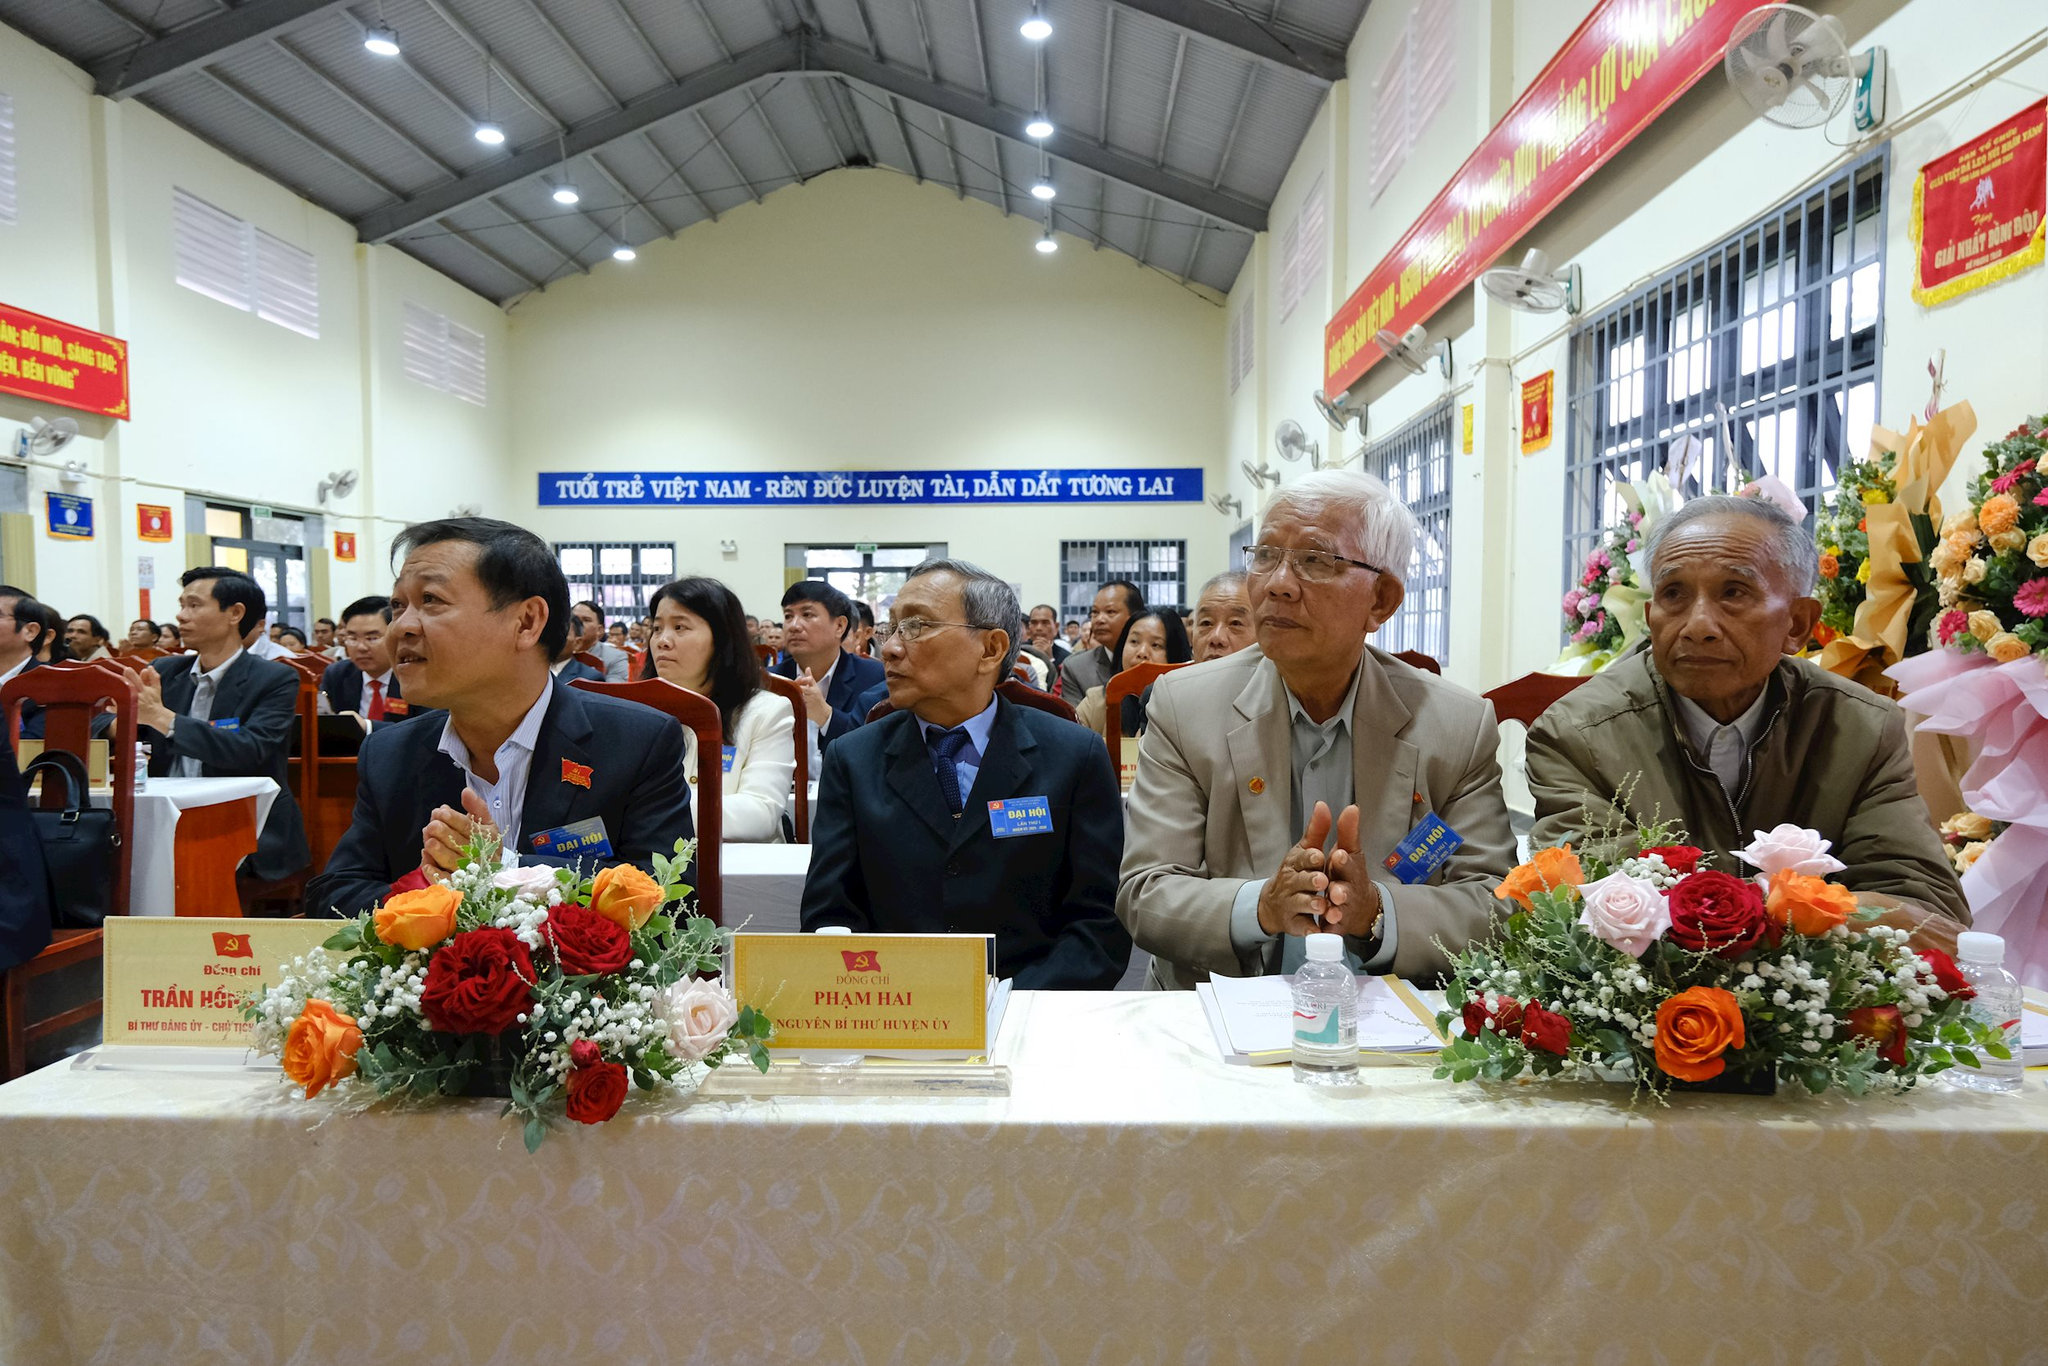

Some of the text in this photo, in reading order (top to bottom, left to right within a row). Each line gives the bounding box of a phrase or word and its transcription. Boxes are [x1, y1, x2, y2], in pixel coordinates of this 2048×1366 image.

[1590, 45, 1616, 125] LỢI
[1934, 239, 1956, 269] GIẢI
[1957, 227, 1987, 261] NHẤT
[2013, 208, 2039, 238] ĐỘI
[556, 473, 599, 499] TUỔI
[603, 474, 645, 499] TRẺ
[650, 476, 699, 501] VIỆT
[704, 480, 751, 499] NAM
[765, 475, 807, 498] RÈN
[813, 476, 852, 498] ĐỨC
[858, 475, 925, 500] LUYỆN
[931, 474, 970, 499] TÀI,
[972, 471, 1016, 497] DẪN
[1068, 474, 1133, 497] TƯƠNG
[1138, 477, 1174, 496] LAI
[1007, 806, 1047, 820] ĐẠI HỘI
[556, 839, 580, 853] ĐẠI
[580, 831, 604, 846] HỘI
[1408, 843, 1430, 864] ĐẠI
[1425, 824, 1447, 846] HỘI
[240, 965, 261, 976] chí
[871, 973, 890, 985] CHÍ
[140, 983, 194, 1008] TRẦN
[814, 991, 912, 1009] PHẠM HAI
[128, 1020, 138, 1031] BÍ
[140, 1020, 160, 1031] THƯ
[190, 1019, 203, 1032] ỦY
[776, 1016, 950, 1032] NGUYÊN BÍ THƯ HUYỆN ỦY
